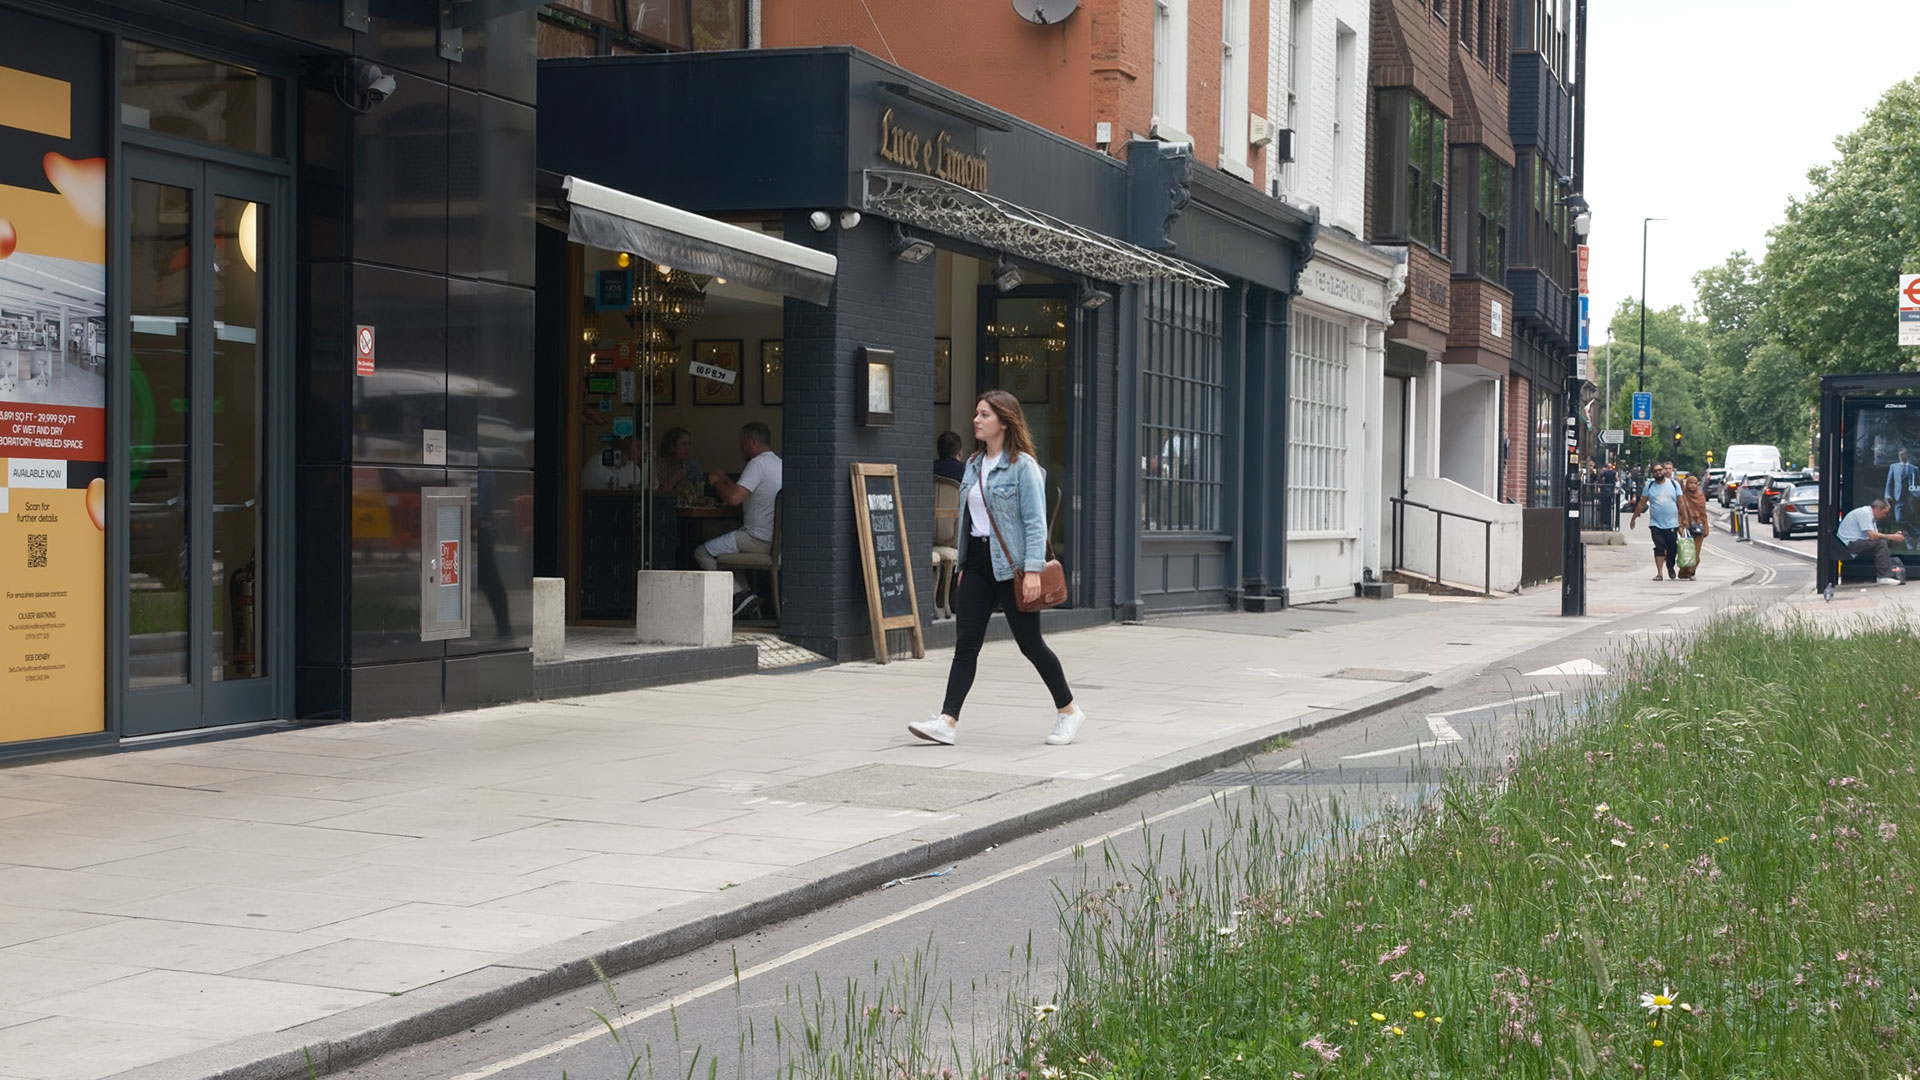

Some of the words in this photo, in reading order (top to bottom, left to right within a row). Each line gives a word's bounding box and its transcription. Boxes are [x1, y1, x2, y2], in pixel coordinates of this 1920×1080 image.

[880, 107, 919, 170] Luce
[922, 138, 933, 176] e
[935, 129, 988, 194] Limoni
[15, 411, 25, 423] SQ
[25, 412, 34, 421] FT
[38, 413, 58, 423] 29,999
[58, 414, 68, 425] SQ
[68, 415, 76, 424] FT
[12, 424, 22, 434] OF
[22, 425, 36, 434] WET
[36, 426, 50, 435] AND
[50, 427, 64, 436] DRY
[63, 440, 84, 449] SPACE
[13, 468, 45, 478] AVAILABLE
[46, 470, 62, 478] NOW
[25, 502, 40, 511] Scan
[42, 502, 50, 511] for
[16, 512, 38, 522] further
[38, 512, 58, 522] details
[440, 543, 450, 559] Dry
[440, 557, 454, 570] Riser
[18, 612, 36, 620] OLIVER
